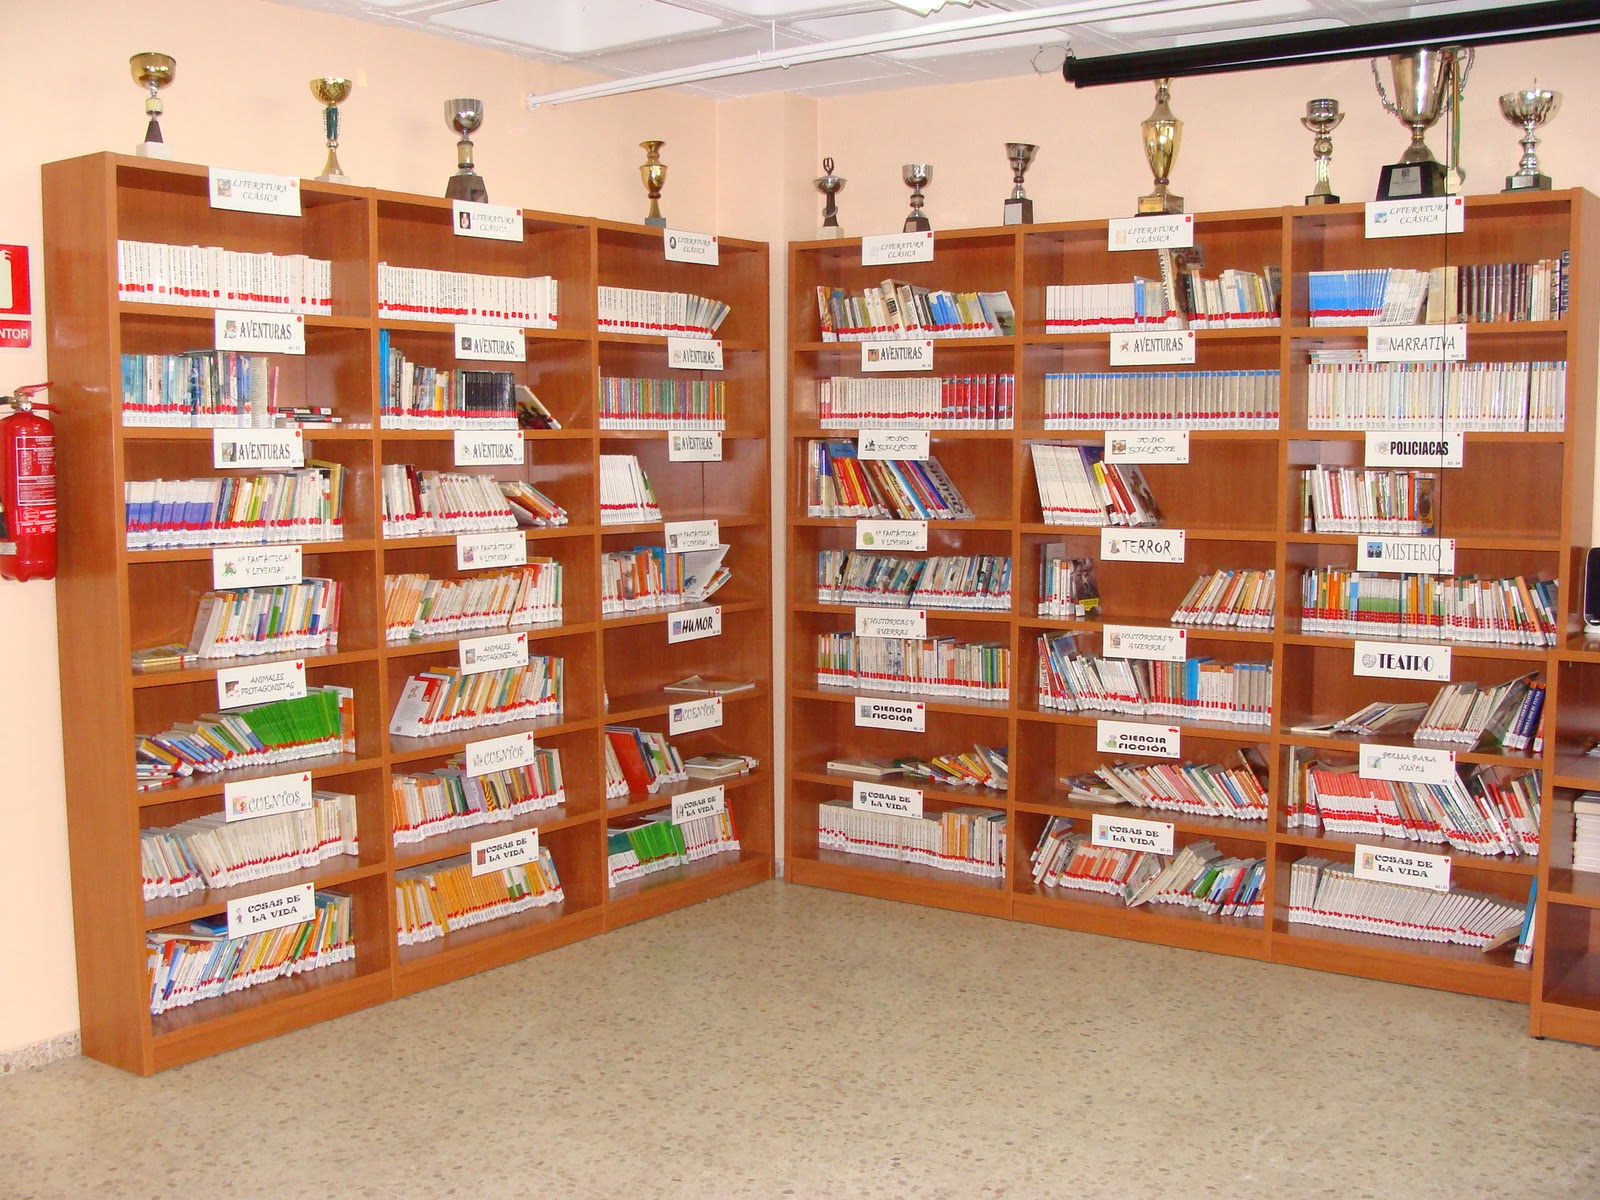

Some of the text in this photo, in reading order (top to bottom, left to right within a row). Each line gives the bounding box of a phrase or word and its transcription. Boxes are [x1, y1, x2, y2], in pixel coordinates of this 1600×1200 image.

[233, 179, 288, 192] LITERATURA
[1390, 204, 1449, 214] LITERATURA
[1399, 214, 1438, 224] CLÁSICA
[1128, 225, 1180, 235] LITERATURA
[881, 241, 924, 250] LITERATURA
[1136, 234, 1170, 243] CLÁSICA
[240, 320, 292, 340] AVENTURAS
[474, 337, 515, 355] AVENTURAS
[1134, 337, 1183, 353] AVENTURAS
[1389, 336, 1455, 351] NARRATIVA
[683, 347, 714, 364] AVENTURAS
[881, 346, 922, 360] AVENTURAS
[682, 436, 713, 450] AVENTURAS
[1390, 441, 1448, 455] POLICIACAS
[238, 441, 290, 460] AVENTURAS
[473, 442, 513, 459] AVENTURAS
[1122, 539, 1172, 555] TERROR
[1385, 542, 1441, 561] MISTERIO
[682, 616, 713, 634] HUMOR
[1121, 632, 1168, 642] HISTÓRICAS
[484, 643, 510, 652] ANIMALES
[1128, 643, 1166, 651] GUERRAS
[476, 650, 518, 662] PROTAGONISTAS
[1378, 653, 1433, 672] TEATRO
[250, 674, 284, 684] ANIMALES
[240, 681, 294, 696] PROTAGONISTAS
[683, 704, 715, 720] CUENTOS
[873, 704, 912, 714] CIENCIA
[872, 712, 913, 722] FICCIÓN
[1120, 734, 1166, 744] CIENCIA
[1119, 742, 1166, 753] FICCIÓN
[484, 745, 525, 765] CUENTOS
[248, 791, 302, 813] CUENTOS
[684, 798, 705, 809] COSAS
[868, 792, 896, 801] COSAS
[686, 808, 696, 816] LA
[698, 804, 714, 812] VIDA
[886, 802, 908, 811] VIDA
[1110, 825, 1159, 837] COSAS DE
[486, 838, 527, 853] COSAS DE
[1130, 837, 1155, 846] VIDA
[489, 848, 525, 862] LA VIDA
[1375, 854, 1433, 868] COSAS DE
[1378, 865, 1428, 878] LA VIDA
[248, 894, 301, 913] COSAS DE
[252, 906, 298, 923] LA VIDA
